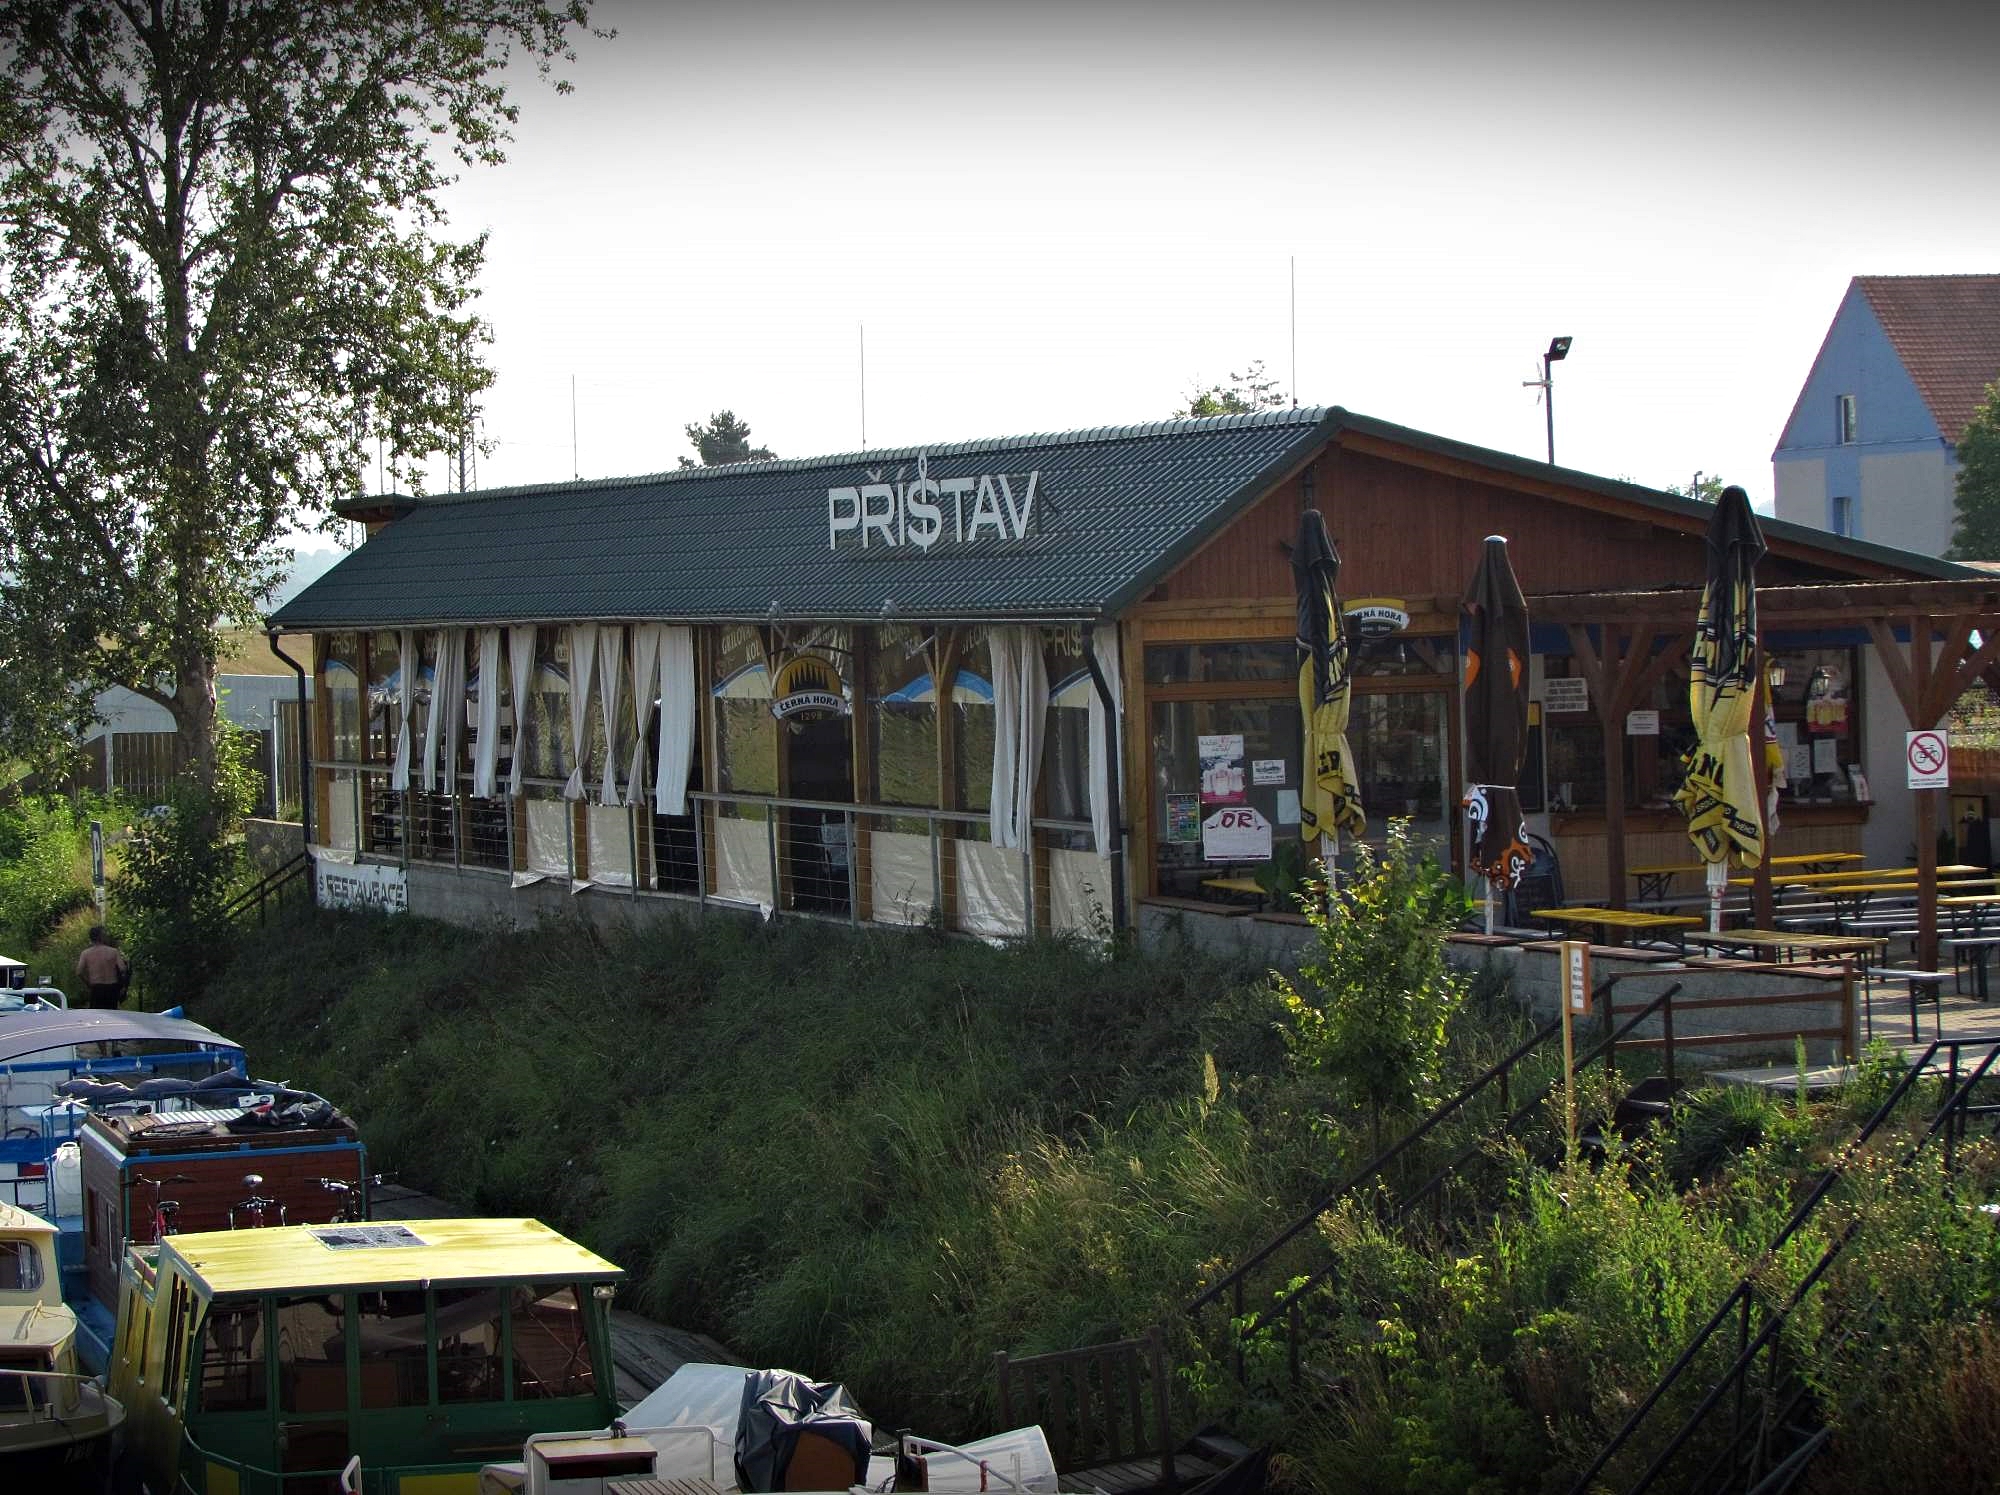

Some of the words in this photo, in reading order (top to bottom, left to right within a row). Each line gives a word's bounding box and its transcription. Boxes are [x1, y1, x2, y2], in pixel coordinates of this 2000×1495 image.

[828, 451, 1039, 554] PŘÍSTAV
[779, 694, 811, 711] ČERNÁ
[813, 695, 839, 707] HORA
[326, 874, 404, 907] RESTAURACE
